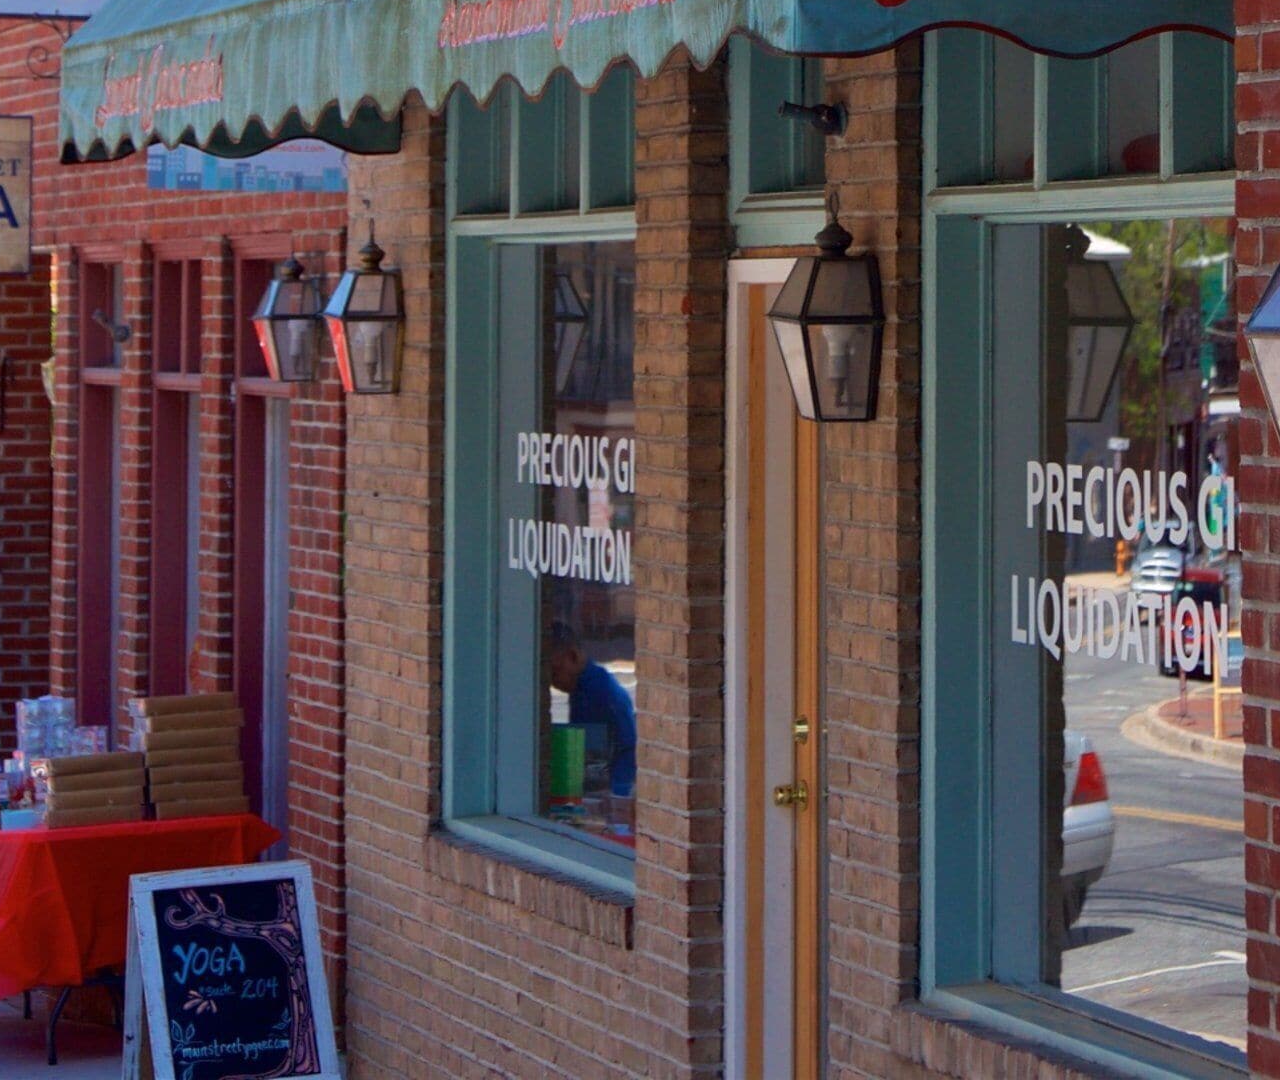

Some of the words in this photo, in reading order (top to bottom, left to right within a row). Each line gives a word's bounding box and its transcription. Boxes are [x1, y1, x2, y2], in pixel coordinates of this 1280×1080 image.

[517, 432, 610, 491] PRECIOUS
[1026, 460, 1188, 546] PRECIOUS
[508, 518, 631, 585] LIQUIDATION
[1010, 574, 1229, 678] LIQUIDATION
[173, 942, 246, 984] YOGA
